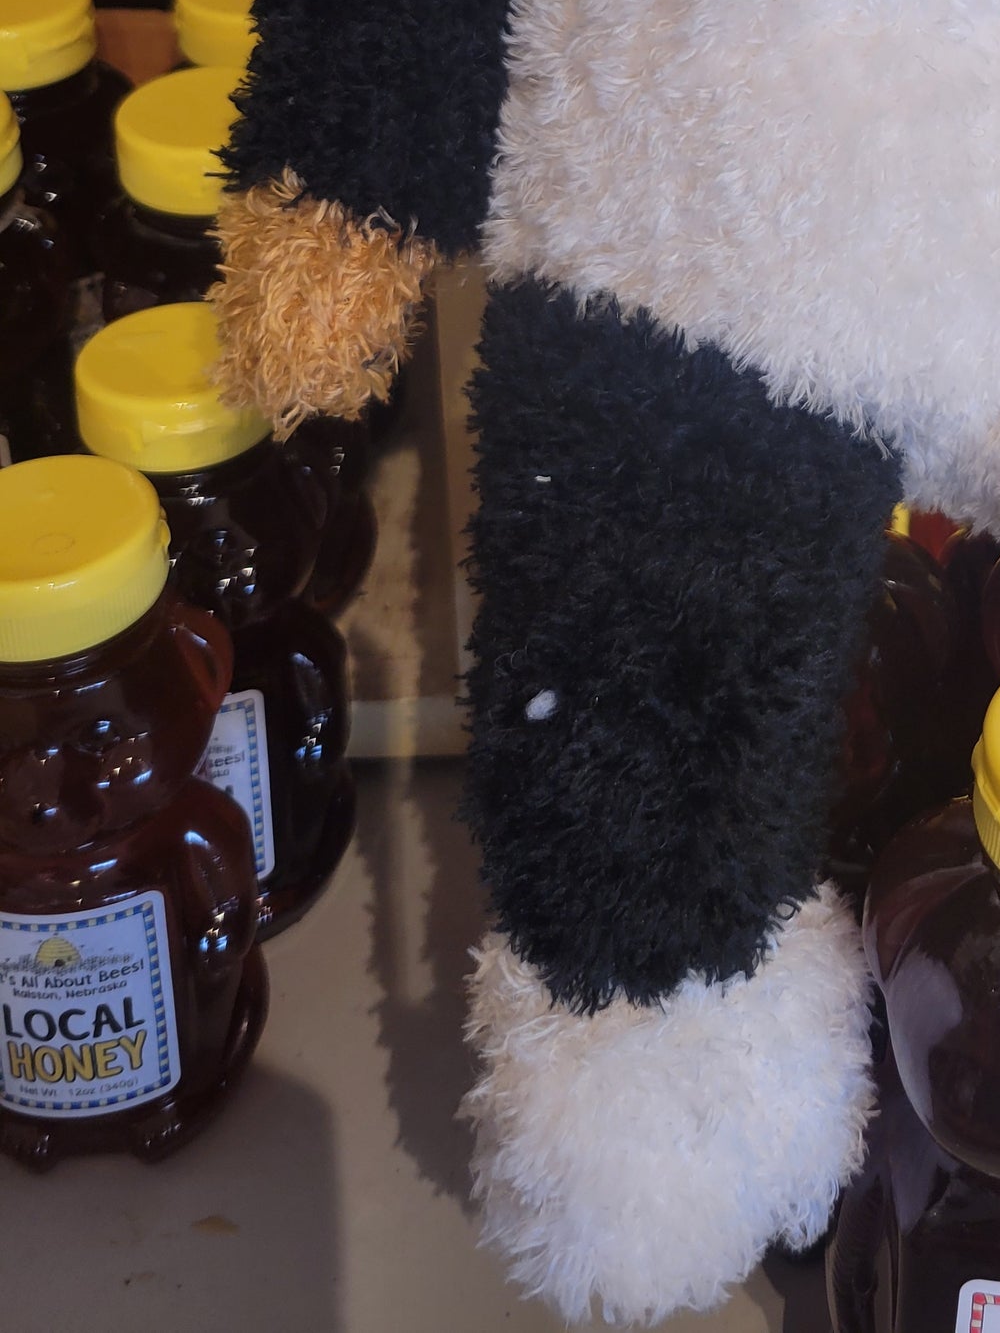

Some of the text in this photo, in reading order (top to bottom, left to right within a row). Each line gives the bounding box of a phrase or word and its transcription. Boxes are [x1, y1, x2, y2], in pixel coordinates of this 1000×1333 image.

[21, 975, 39, 988] All
[44, 974, 93, 989] About
[98, 958, 145, 983] Bees!
[65, 979, 128, 999] Nebraska
[2, 996, 146, 1043] LOCAL
[7, 1028, 148, 1084] HONEY
